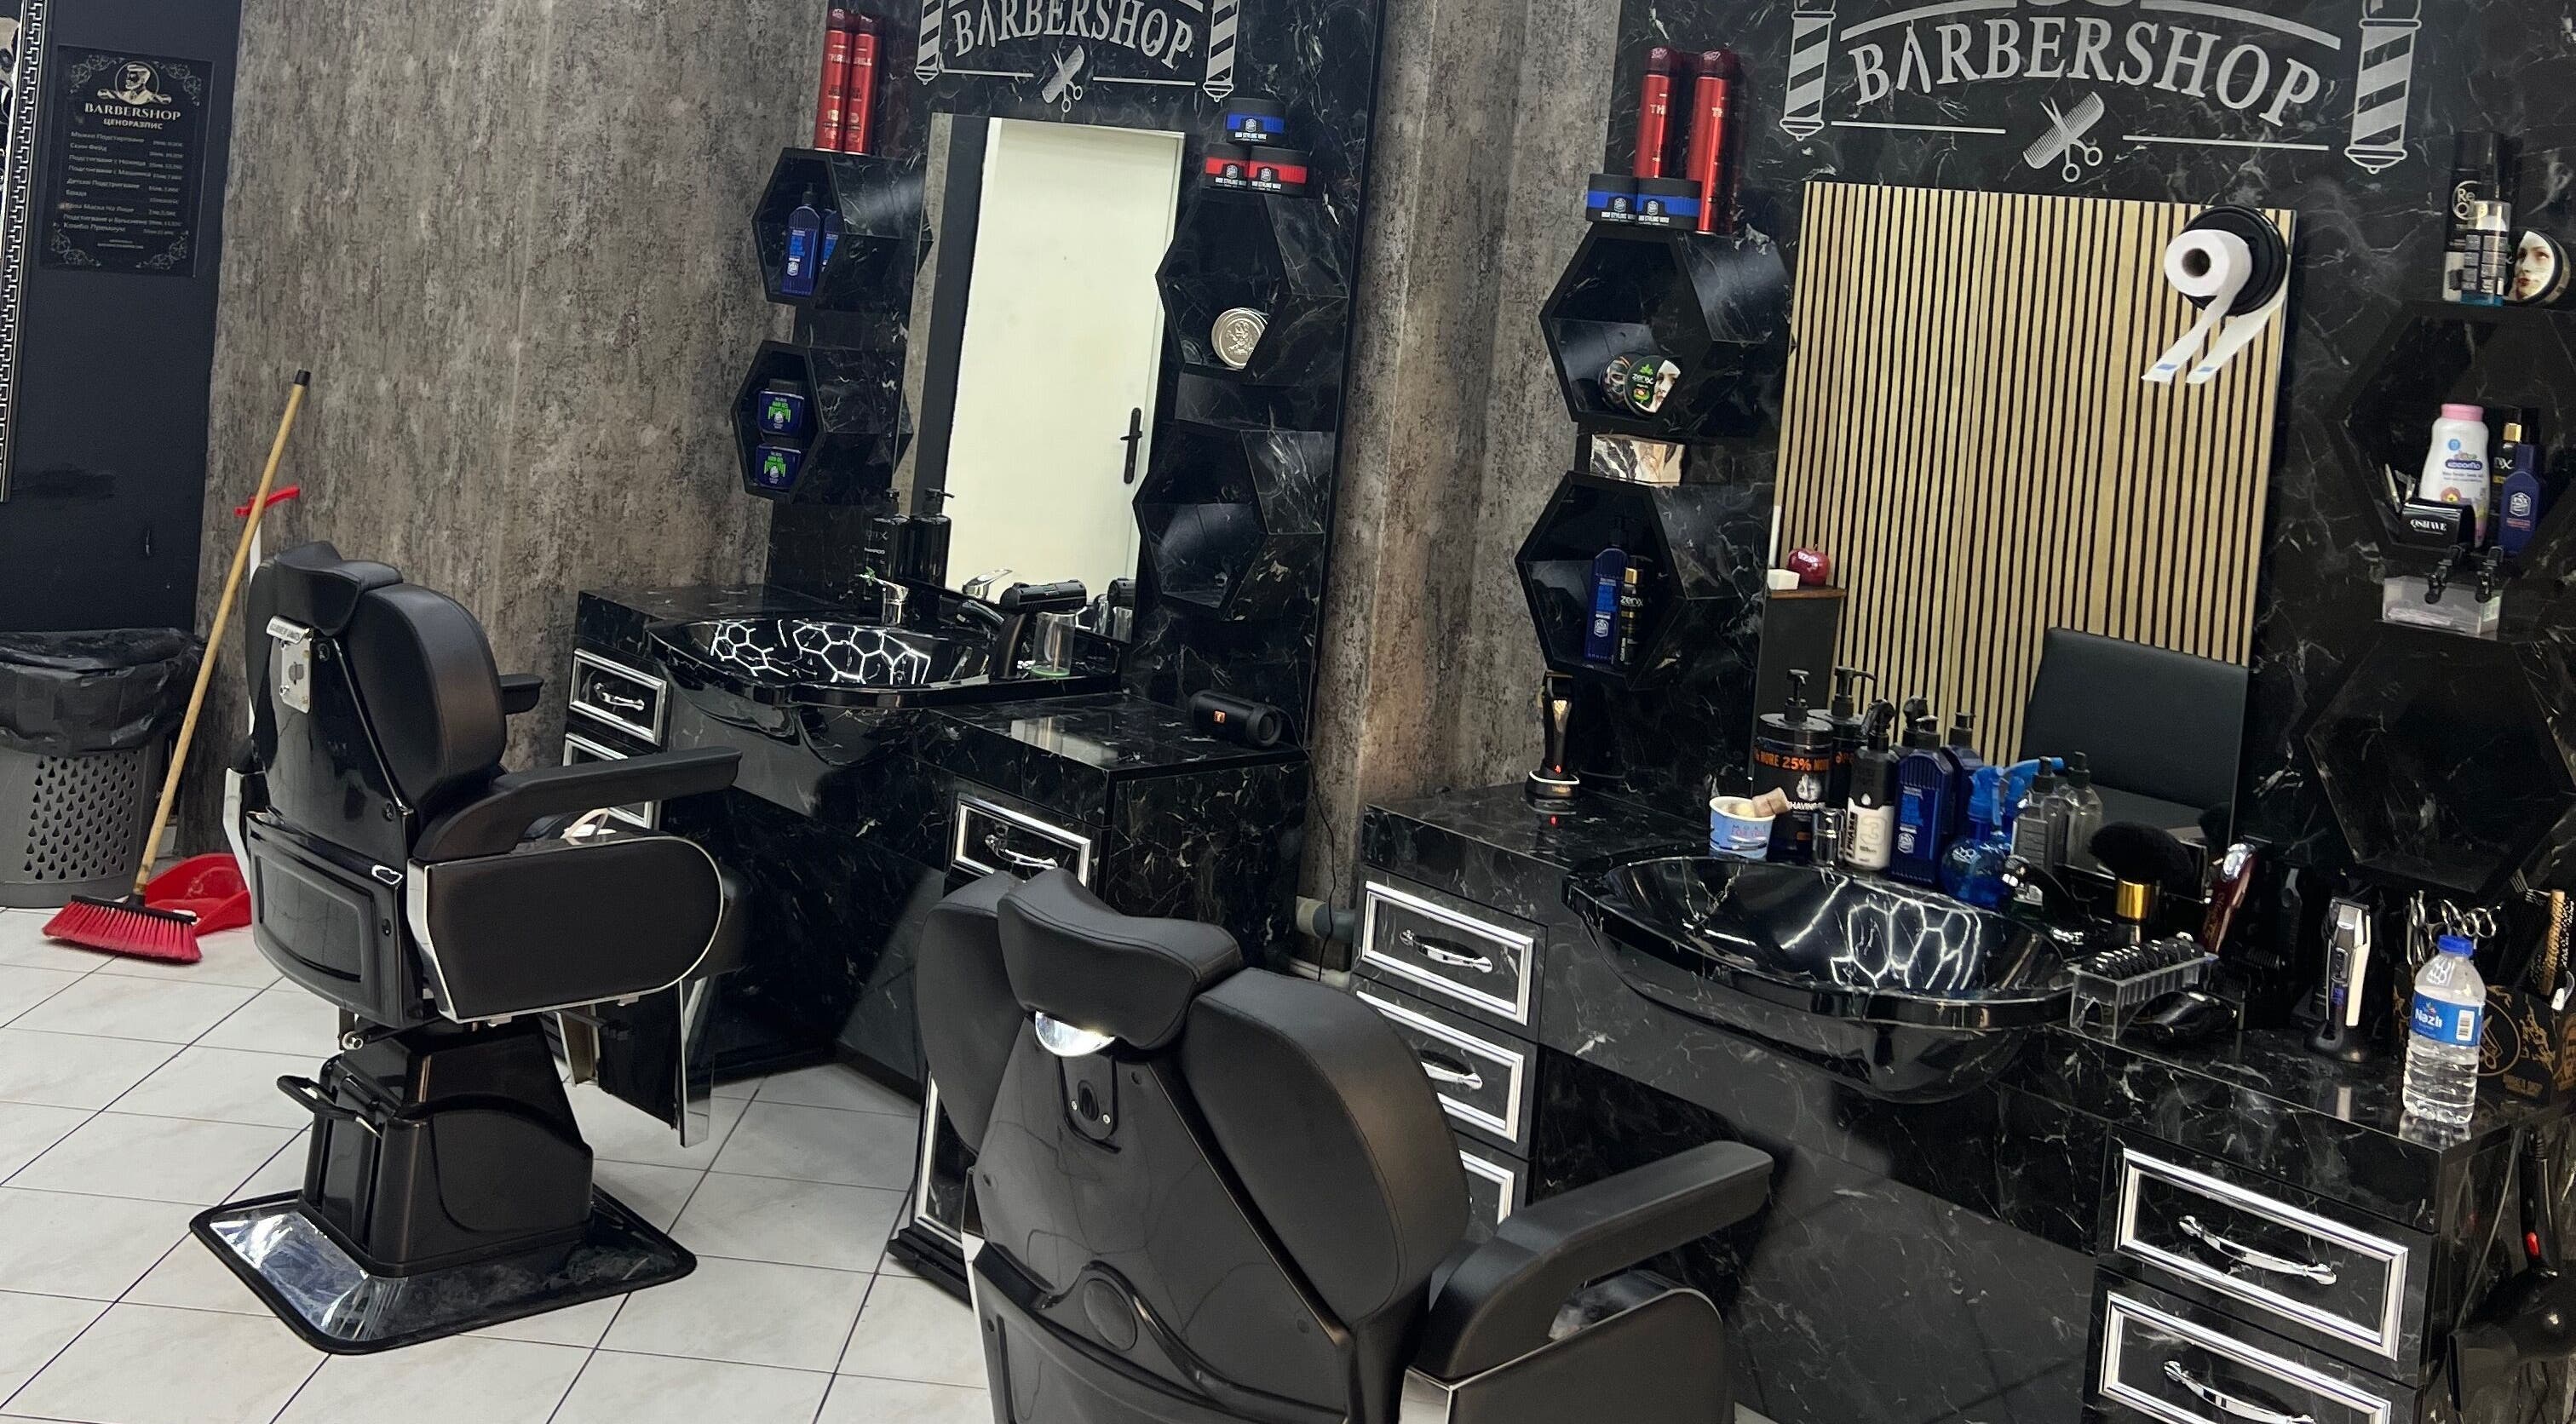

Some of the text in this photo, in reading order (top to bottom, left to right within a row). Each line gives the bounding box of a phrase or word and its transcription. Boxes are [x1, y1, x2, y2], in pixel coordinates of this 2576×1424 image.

[952, 0, 1193, 70] BARBERSHOP
[1848, 16, 2320, 128] BARBERSHOP
[84, 102, 181, 121] BARBERSHOP
[103, 118, 164, 129] ЦЕНОРАЗПИС
[1782, 755, 1812, 771] 25%
